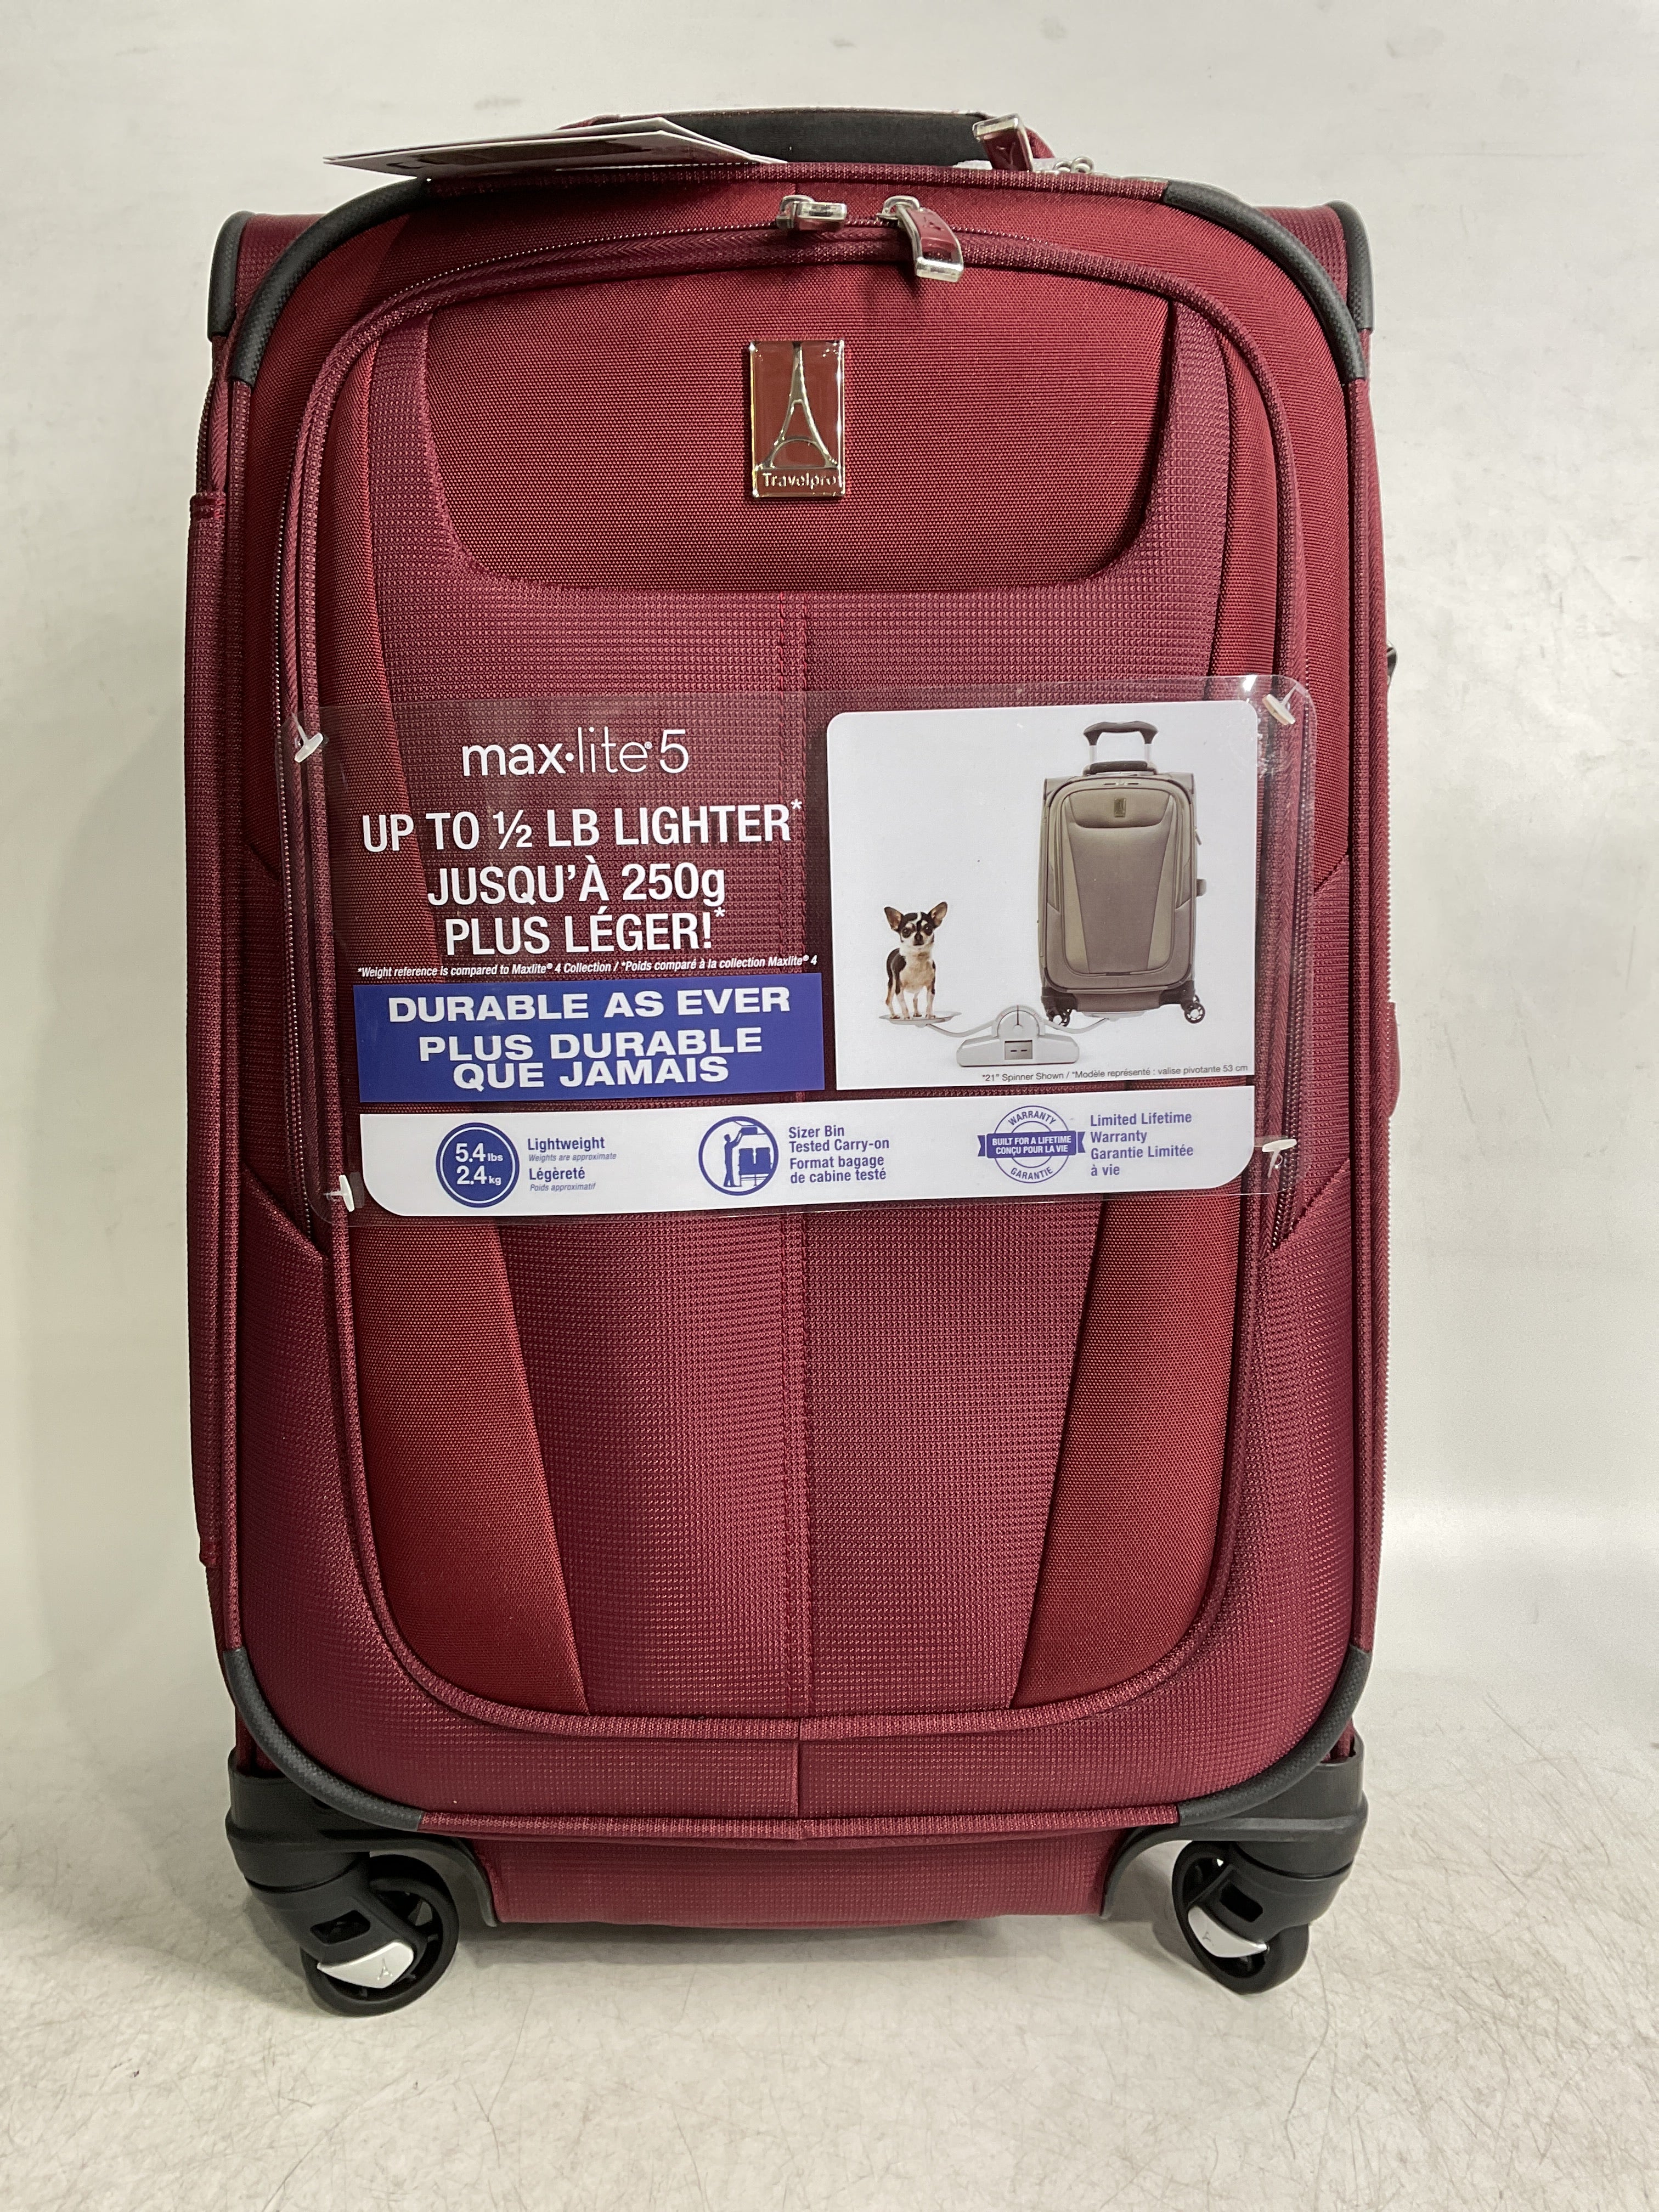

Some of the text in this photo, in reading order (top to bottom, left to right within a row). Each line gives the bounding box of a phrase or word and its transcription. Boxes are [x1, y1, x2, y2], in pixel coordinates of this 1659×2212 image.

[762, 472, 837, 489] Travelpro
[659, 729, 690, 774] 5
[362, 814, 414, 853] UP
[426, 812, 481, 850] TO
[548, 808, 600, 847] LB
[622, 861, 726, 907] 250g
[445, 916, 550, 956] PLUS
[394, 967, 438, 977] reference
[440, 966, 449, 976] is
[450, 965, 498, 978] compared
[500, 964, 510, 974] to
[554, 963, 562, 973] 4
[564, 961, 612, 973] Collection
[654, 958, 697, 972] comparé
[699, 958, 705, 968] à
[708, 958, 717, 968] la
[719, 956, 766, 968] collection
[810, 955, 818, 965] 4
[388, 987, 790, 1023] DURABLE AS EVER
[419, 1028, 763, 1062] PLUS DURABLE
[453, 1057, 729, 1092] QUE JAMAIS
[1002, 1073, 1034, 1082] Spinner
[1036, 1071, 1064, 1080] Shown
[1107, 1068, 1151, 1078] représenté
[1158, 1066, 1181, 1075] valise
[1183, 1064, 1221, 1075] pivotante
[1008, 1110, 1057, 1126] WARRANTY
[1090, 1111, 1192, 1126] Limited Lifetime
[788, 1125, 845, 1139] Sizer Bin
[1090, 1130, 1148, 1143] Warranty
[527, 1137, 606, 1153] Lightweight
[789, 1138, 890, 1153] Tested Carry-on
[992, 1137, 1013, 1146] BUILT
[1014, 1137, 1029, 1145] FOR
[1038, 1135, 1071, 1144] LIFETIME
[455, 1142, 504, 1163] 5.4 lbs
[528, 1154, 556, 1163] Weights
[572, 1152, 617, 1162] approximate
[996, 1147, 1021, 1156] CONÇU
[1091, 1144, 1194, 1160] Garantie Limitée
[790, 1155, 884, 1170] Format bagage
[1091, 1164, 1120, 1176] à vie
[456, 1165, 501, 1186] 2.4 kg
[529, 1166, 585, 1182] Légèreté
[791, 1167, 887, 1184] de cabine testé
[1010, 1166, 1053, 1180] GARANTIE
[529, 1182, 596, 1192] Poids approximatif
